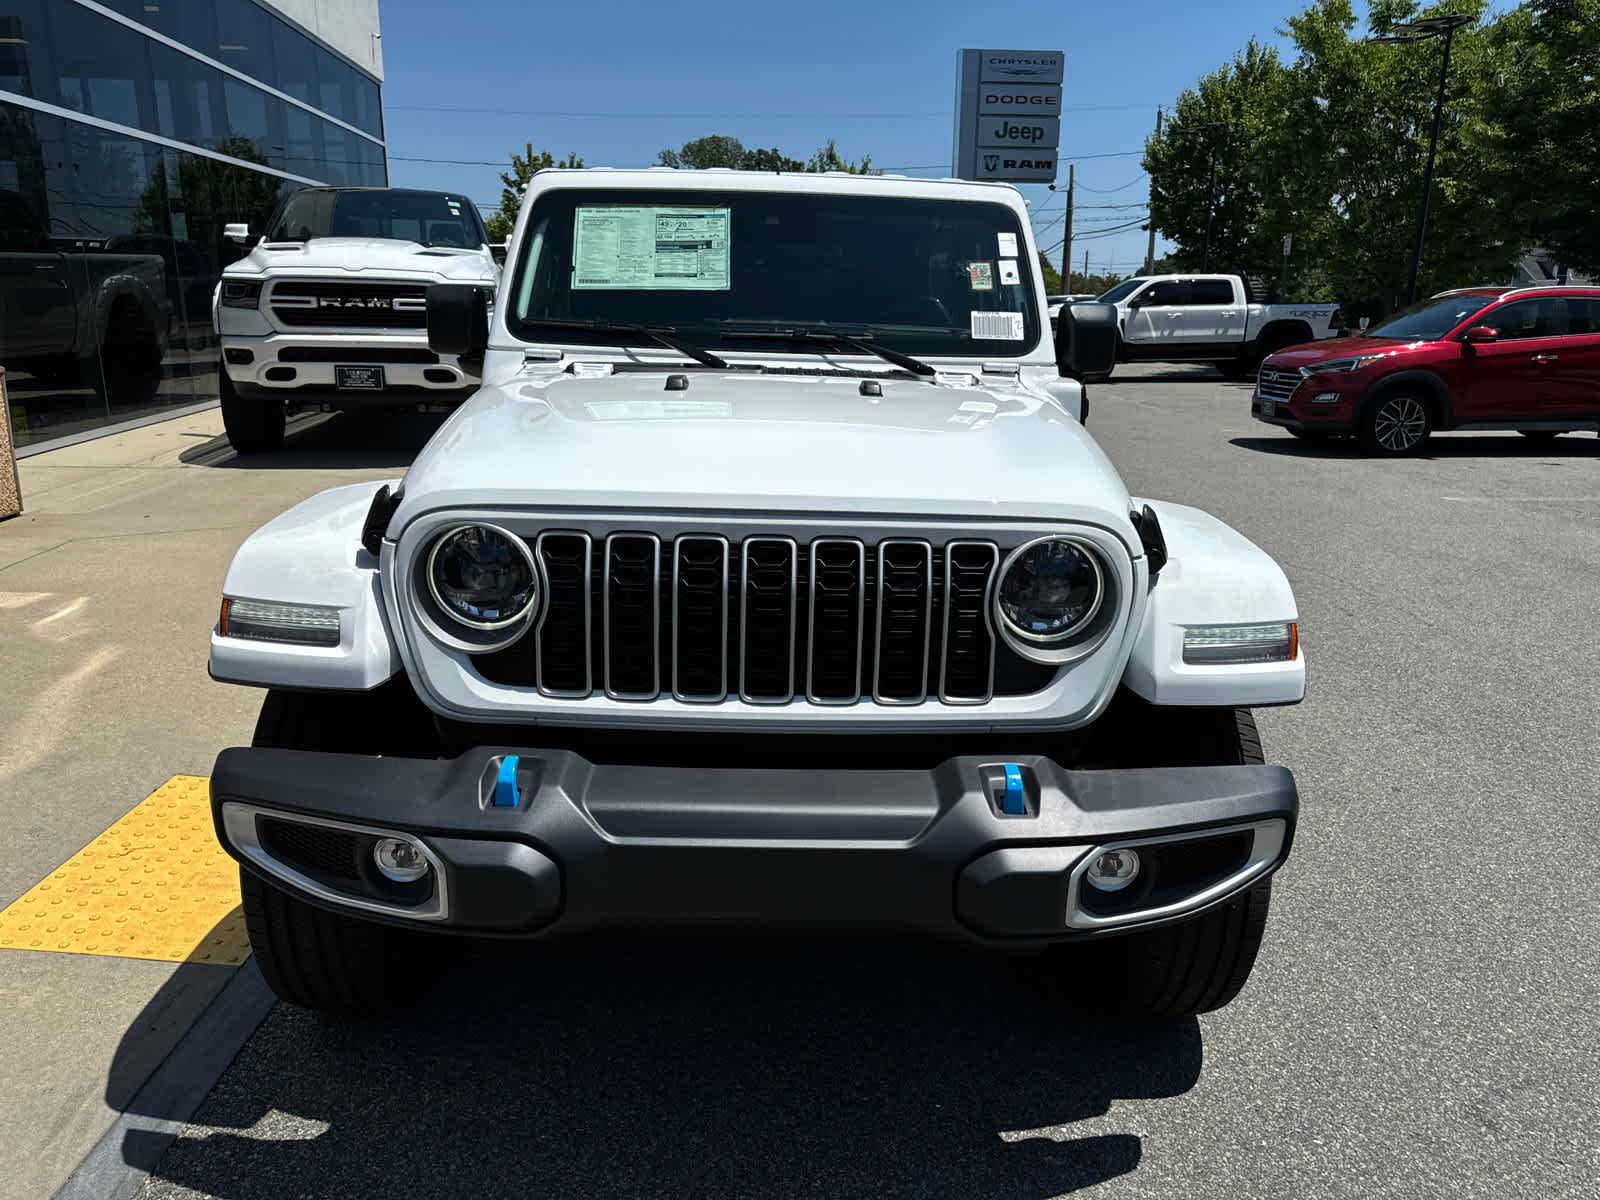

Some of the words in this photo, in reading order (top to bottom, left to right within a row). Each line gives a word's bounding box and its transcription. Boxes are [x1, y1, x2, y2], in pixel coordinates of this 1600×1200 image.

[989, 58, 1057, 66] CHRYSLER
[985, 94, 1057, 105] DODGE
[994, 120, 1045, 143] Jeep
[1003, 159, 1053, 169] RAM
[319, 297, 391, 308] RAM
